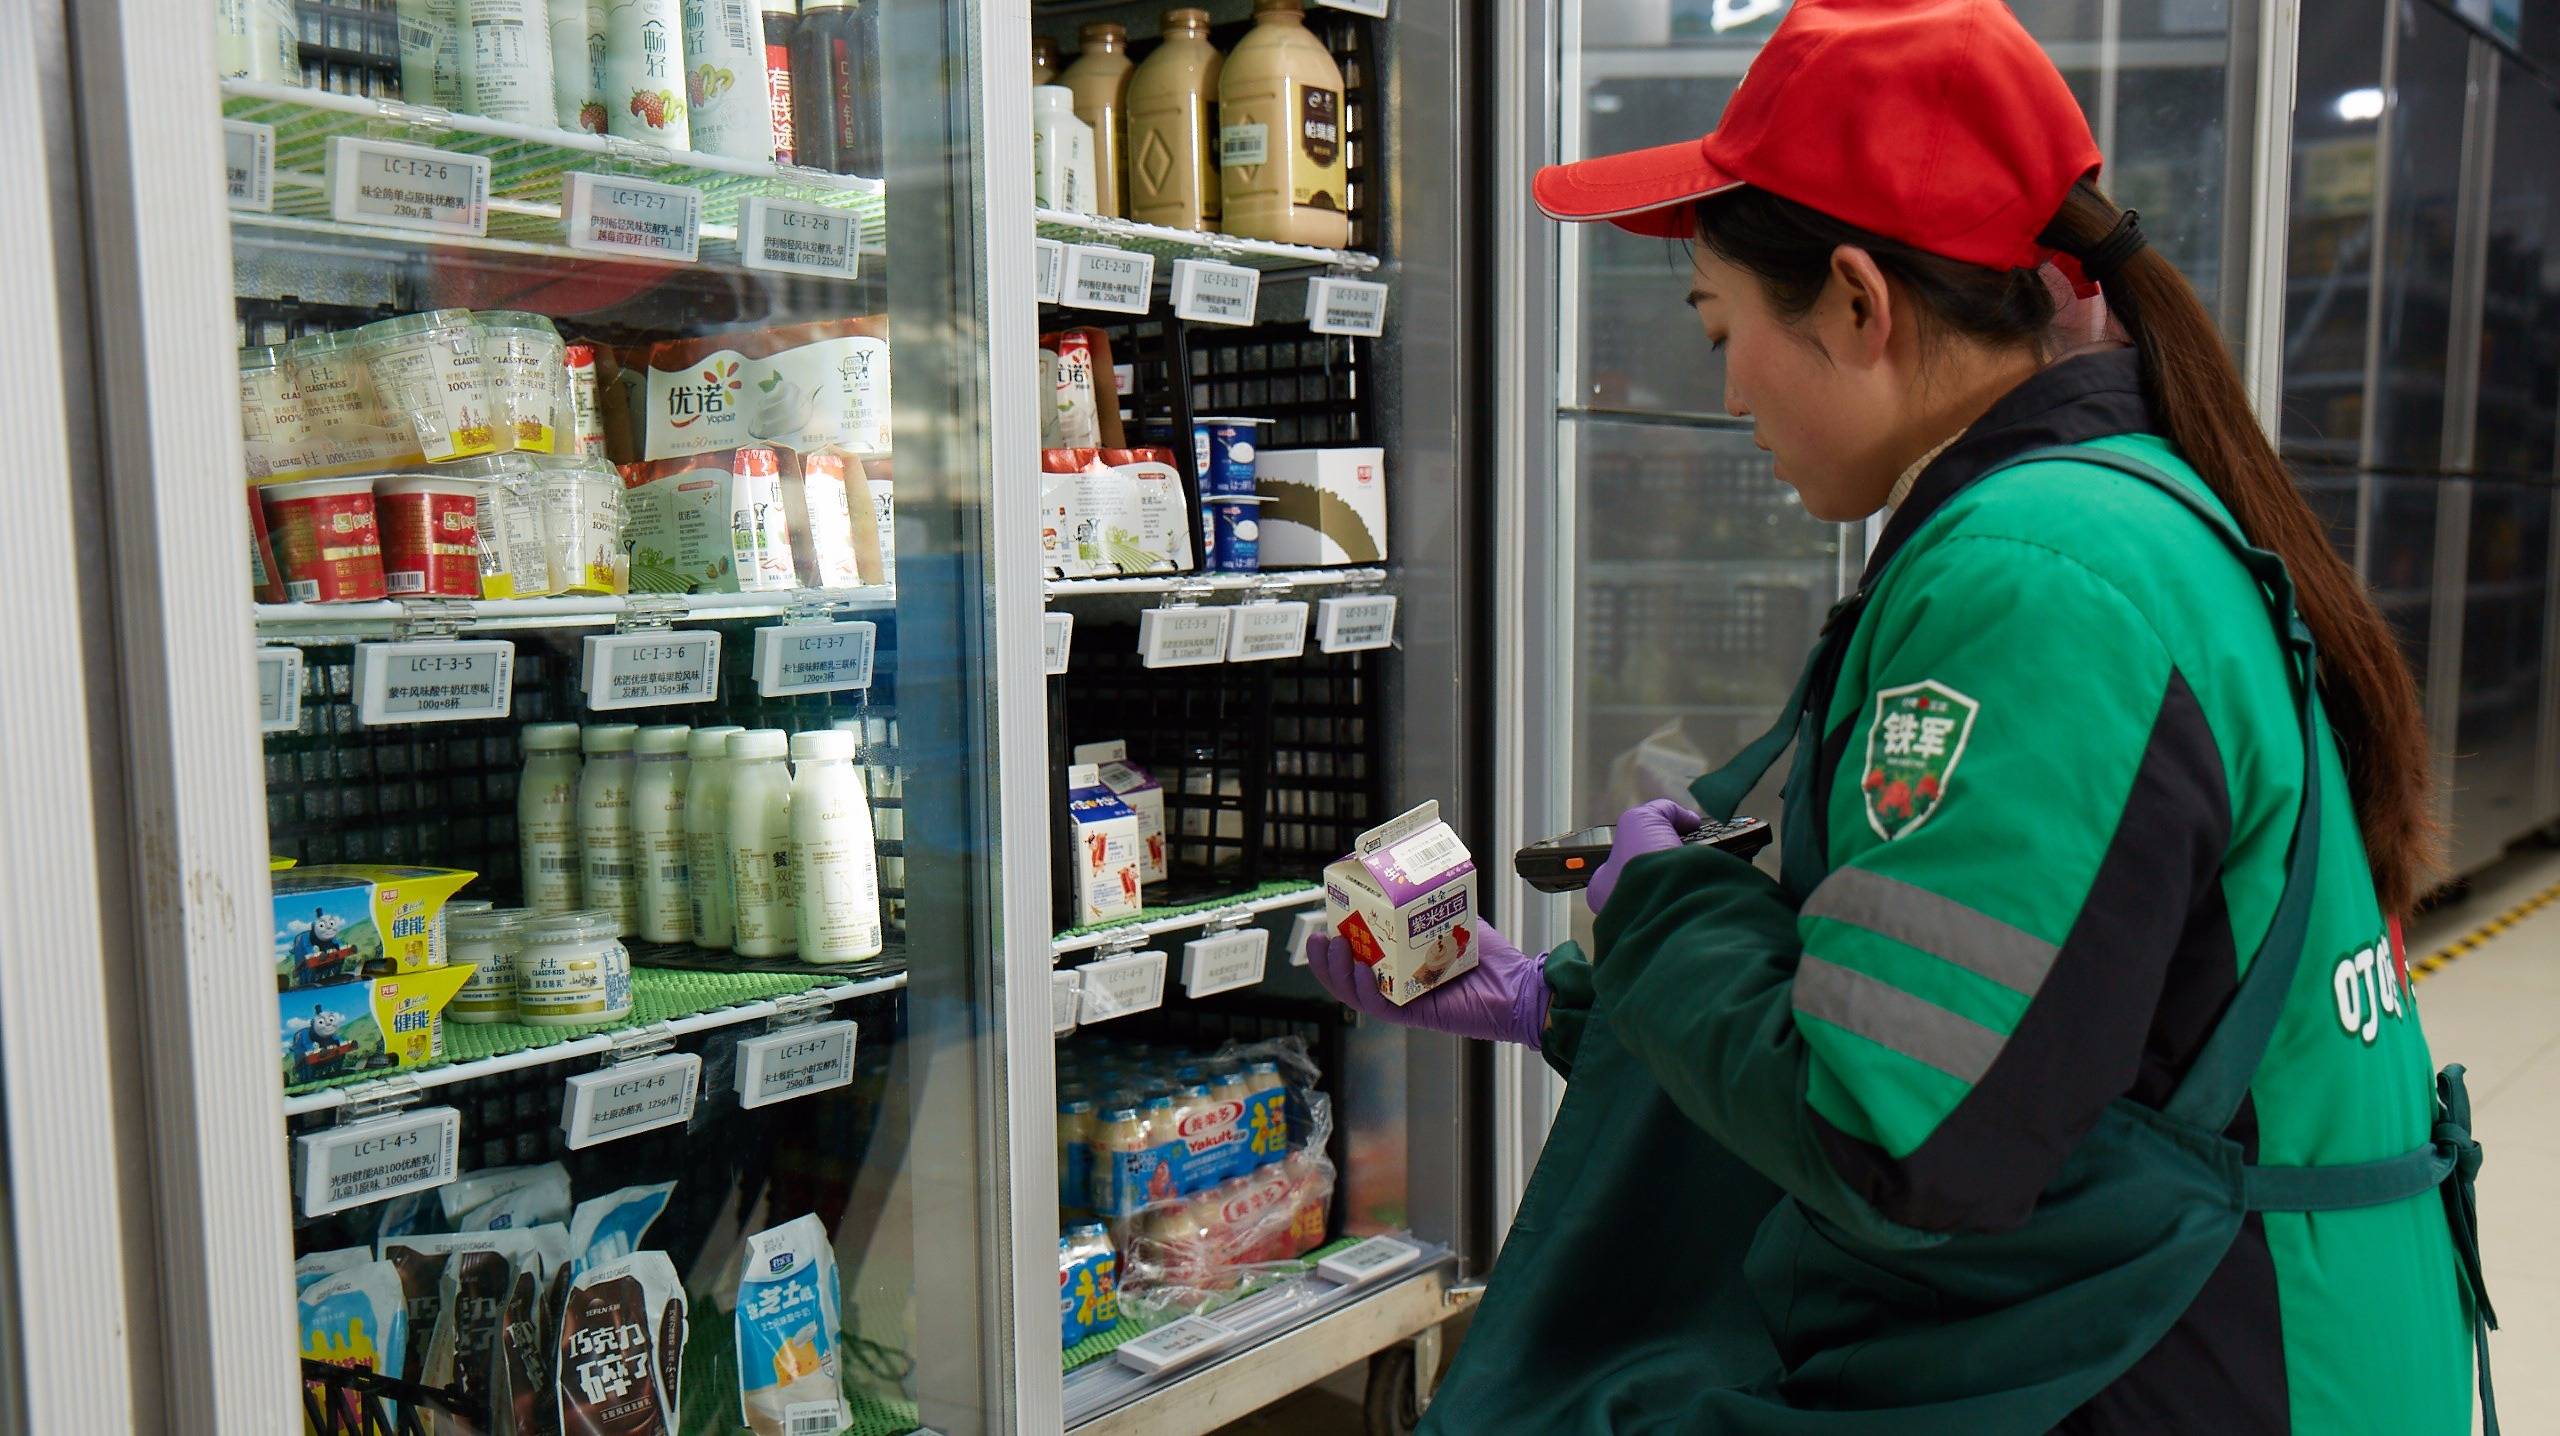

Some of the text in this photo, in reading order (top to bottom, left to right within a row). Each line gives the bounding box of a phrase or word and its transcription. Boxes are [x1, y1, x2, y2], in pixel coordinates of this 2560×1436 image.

[642, 28, 667, 79] 畅轻
[384, 158, 448, 180] LC-I-2-6
[612, 191, 666, 209] LC-I-2-7
[783, 213, 830, 231] LC-I-2-8
[668, 383, 723, 415] 优诺
[633, 646, 686, 661] LC-I-3-6
[799, 637, 845, 651] LC-I-3-7
[411, 657, 473, 672] LC-I-3-5
[1882, 711, 1956, 758] 铁军
[1411, 893, 1466, 934] 紫米红豆
[392, 915, 426, 939] 健能
[394, 1009, 431, 1033] 健能
[781, 1040, 826, 1060] LC-I-4-7
[613, 1075, 665, 1098] LC-I-4-6
[354, 1131, 418, 1157] LC-I-4-5
[1190, 1130, 1232, 1152] Yakult
[568, 1323, 646, 1358] 巧克力
[576, 1352, 648, 1405] 碎了
